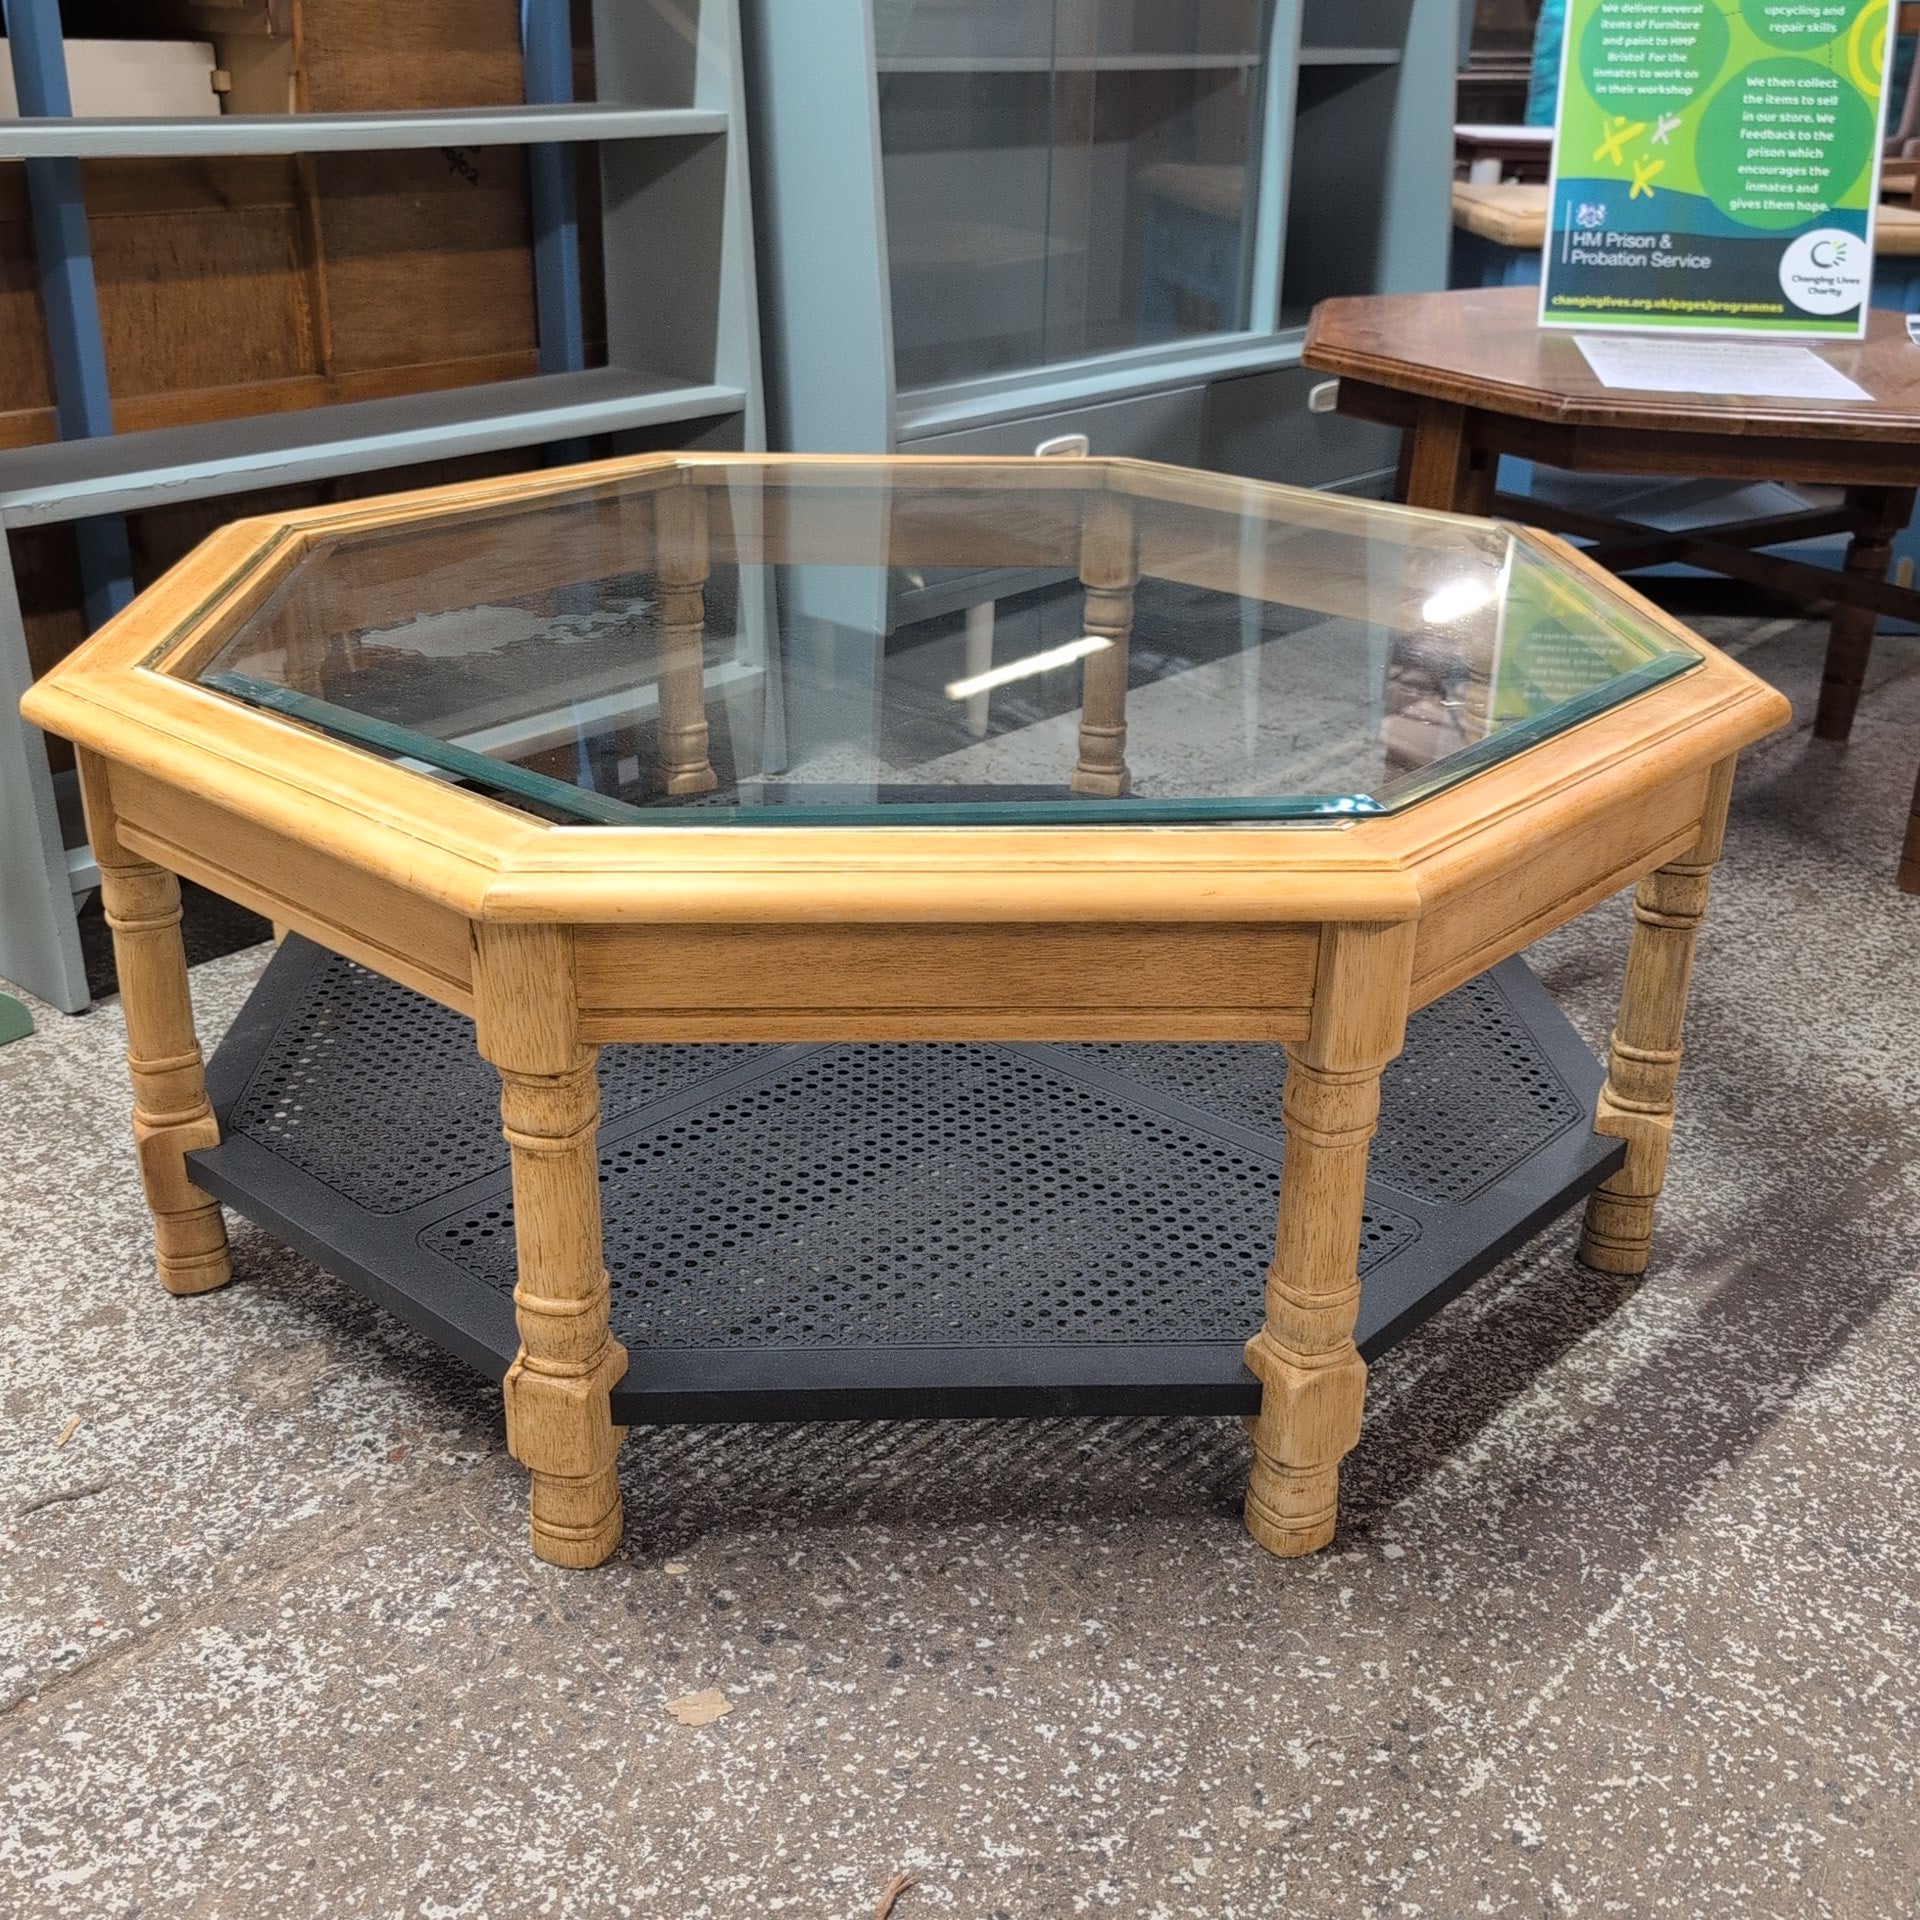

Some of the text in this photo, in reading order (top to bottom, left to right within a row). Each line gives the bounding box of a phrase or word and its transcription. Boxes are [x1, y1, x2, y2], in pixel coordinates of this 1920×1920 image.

[1602, 4, 1704, 13] We deliver several
[1764, 5, 1845, 18] upcycling and
[1600, 20, 1632, 30] items
[1634, 19, 1647, 30] of
[1769, 22, 1837, 34] repair skills
[1602, 36, 1696, 48] and paint to HMP
[1607, 52, 1645, 62] Bristol
[1667, 52, 1687, 62] the
[1592, 68, 1699, 79] inmates to work on
[1746, 77, 1838, 89] We then collect
[1595, 84, 1694, 97] in their workshop
[1742, 93, 1838, 106] the items to sell
[1742, 110, 1754, 122] in
[1756, 113, 1777, 122] our
[1816, 113, 1836, 124] We
[1798, 131, 1812, 141] to
[1813, 131, 1834, 141] the
[1746, 147, 1824, 159] prison which
[1737, 165, 1830, 178] encourages the
[1745, 181, 1819, 194] inmates and
[1729, 198, 1762, 211] gives
[1763, 199, 1795, 210] them
[1572, 231, 1673, 249] HM Prison &
[1571, 249, 1712, 269] Probation Service
[1792, 274, 1860, 285] Changing Lives
[1808, 287, 1842, 297] Charity
